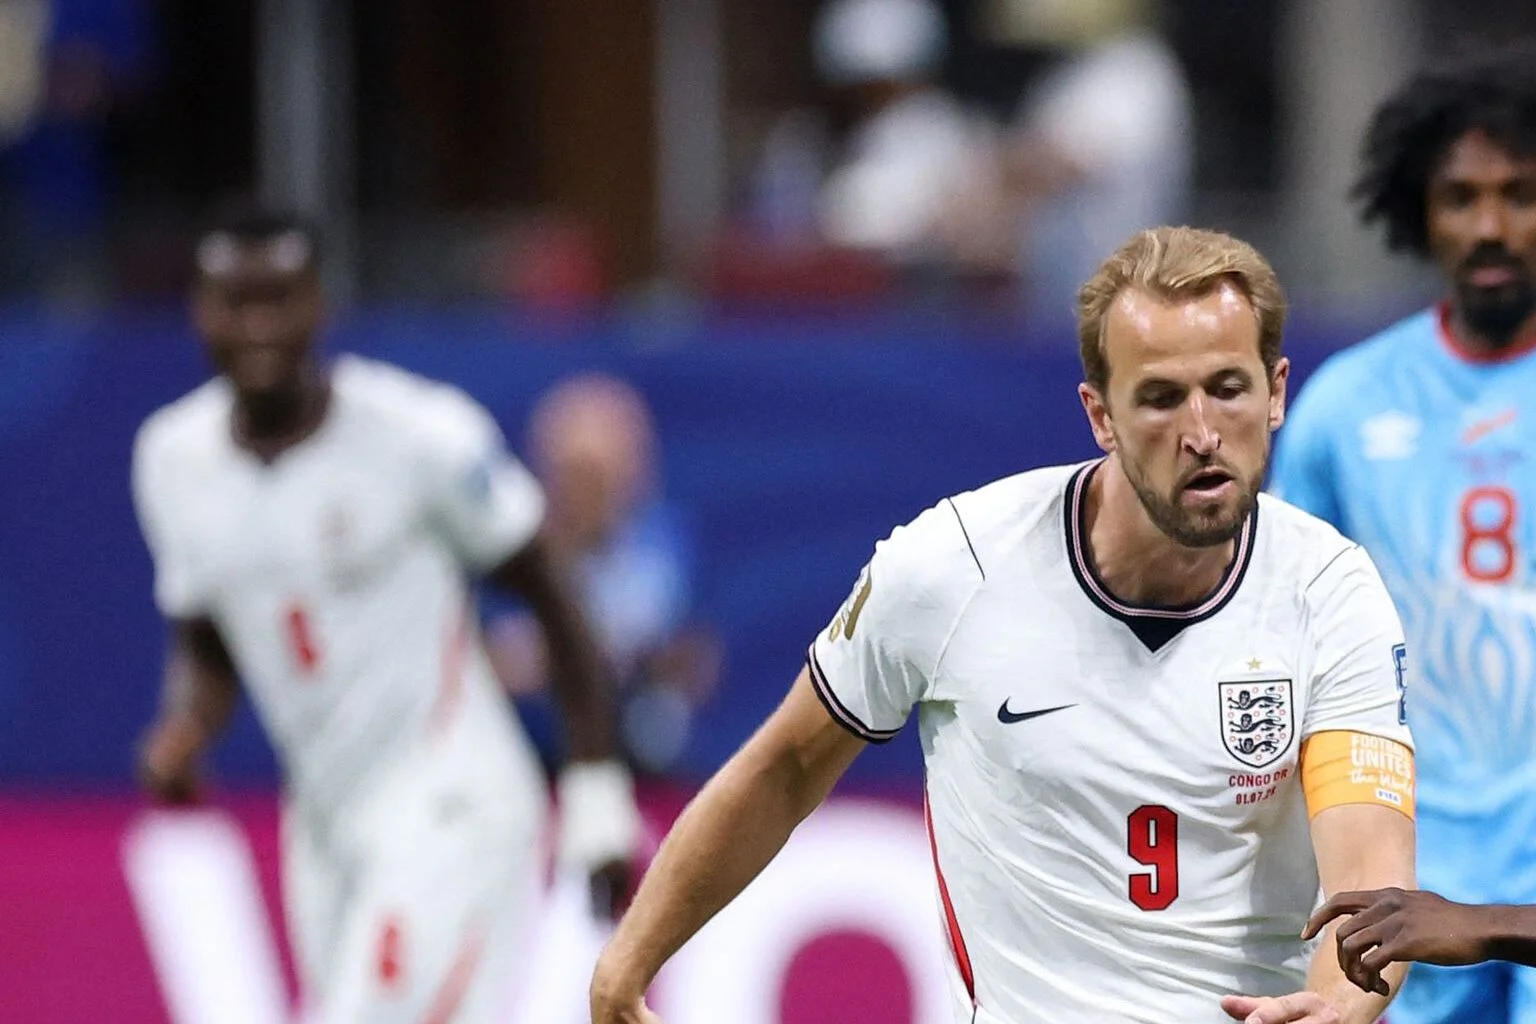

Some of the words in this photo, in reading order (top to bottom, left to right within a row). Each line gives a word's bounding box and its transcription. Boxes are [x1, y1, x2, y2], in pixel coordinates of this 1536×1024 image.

[1460, 486, 1518, 585] 8
[1229, 774, 1271, 787] CONGO
[1273, 769, 1288, 781] DR
[1352, 749, 1410, 779] UNITES
[1127, 804, 1179, 911] 9
